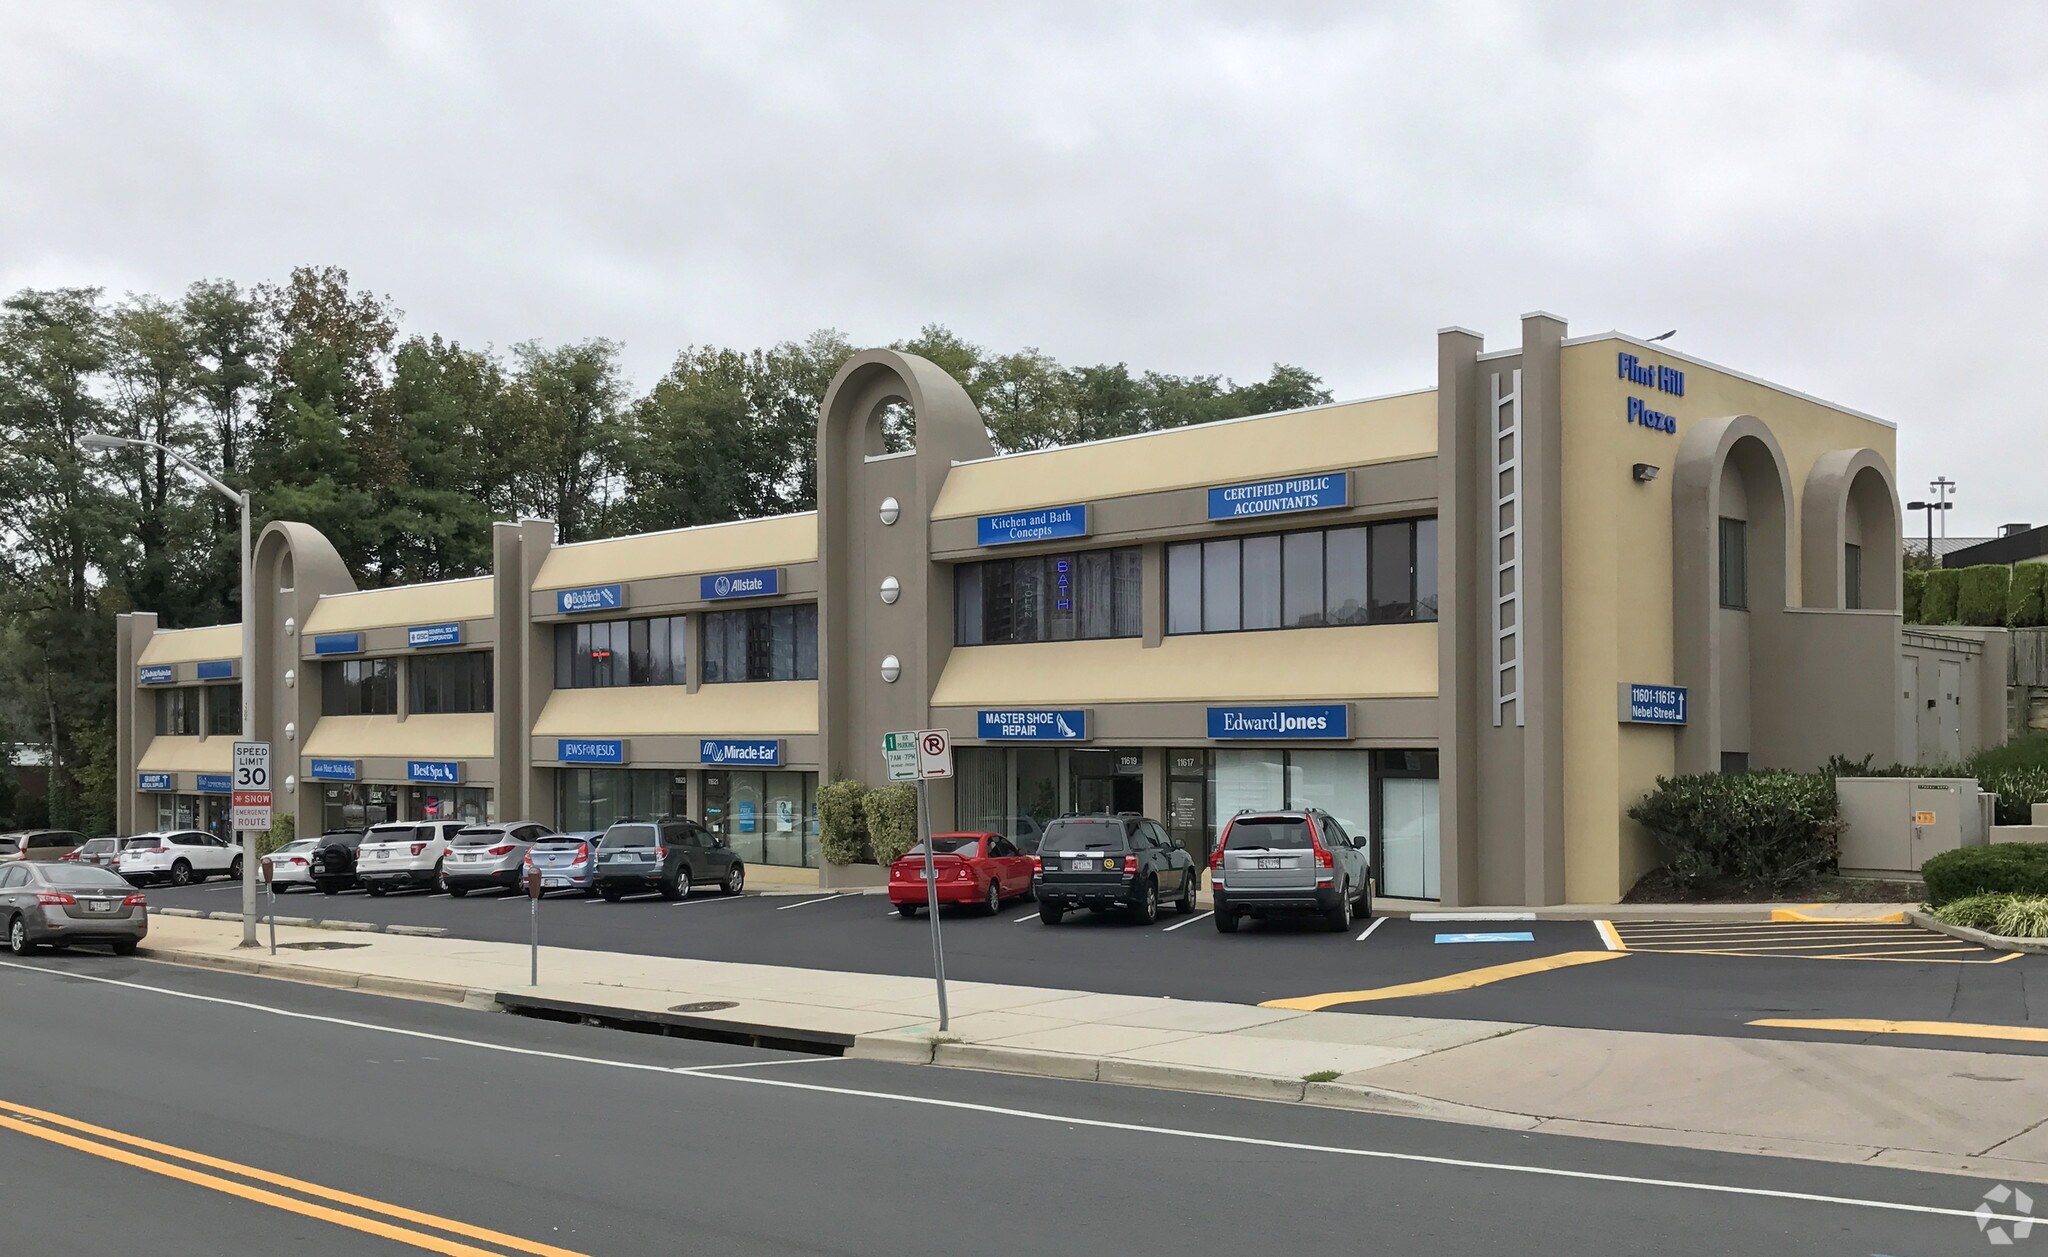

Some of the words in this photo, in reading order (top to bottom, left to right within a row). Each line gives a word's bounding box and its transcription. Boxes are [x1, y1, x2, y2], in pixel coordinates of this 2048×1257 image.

[1618, 352, 1656, 388] Flint
[1658, 365, 1685, 397] Hill
[1627, 396, 1676, 434] Plaza
[1224, 483, 1284, 501] CERTIFIED
[1286, 477, 1330, 494] PUBLIC
[1234, 494, 1318, 515] ACCOUNTANTS
[991, 516, 1027, 530] Kitchen
[1029, 513, 1046, 526] and
[1049, 510, 1072, 523] Bath
[1009, 526, 1052, 539] Concepts
[731, 577, 763, 592] Allstate
[1057, 560, 1069, 610] BATH
[572, 589, 600, 605] BodyTech
[1632, 688, 1676, 705] 11601-11615
[985, 713, 1025, 724] MASTER
[1027, 713, 1054, 724] SHOE
[1632, 705, 1653, 718] Nebel
[1653, 706, 1676, 719] Street
[1002, 725, 1037, 736] REPAIR
[889, 736, 894, 749] 1
[236, 747, 268, 756] SPEED
[565, 743, 583, 757] JEWS
[595, 744, 616, 758] JESUS
[724, 745, 775, 760] Miracle-Ear
[239, 758, 264, 766] LIMIT
[1120, 757, 1138, 765] 11619
[1176, 758, 1194, 767] 11617
[238, 767, 266, 786] 30
[413, 764, 430, 777] Best
[430, 764, 443, 780] Spa
[244, 794, 270, 803] SNOW
[238, 818, 266, 826] ROUTE
